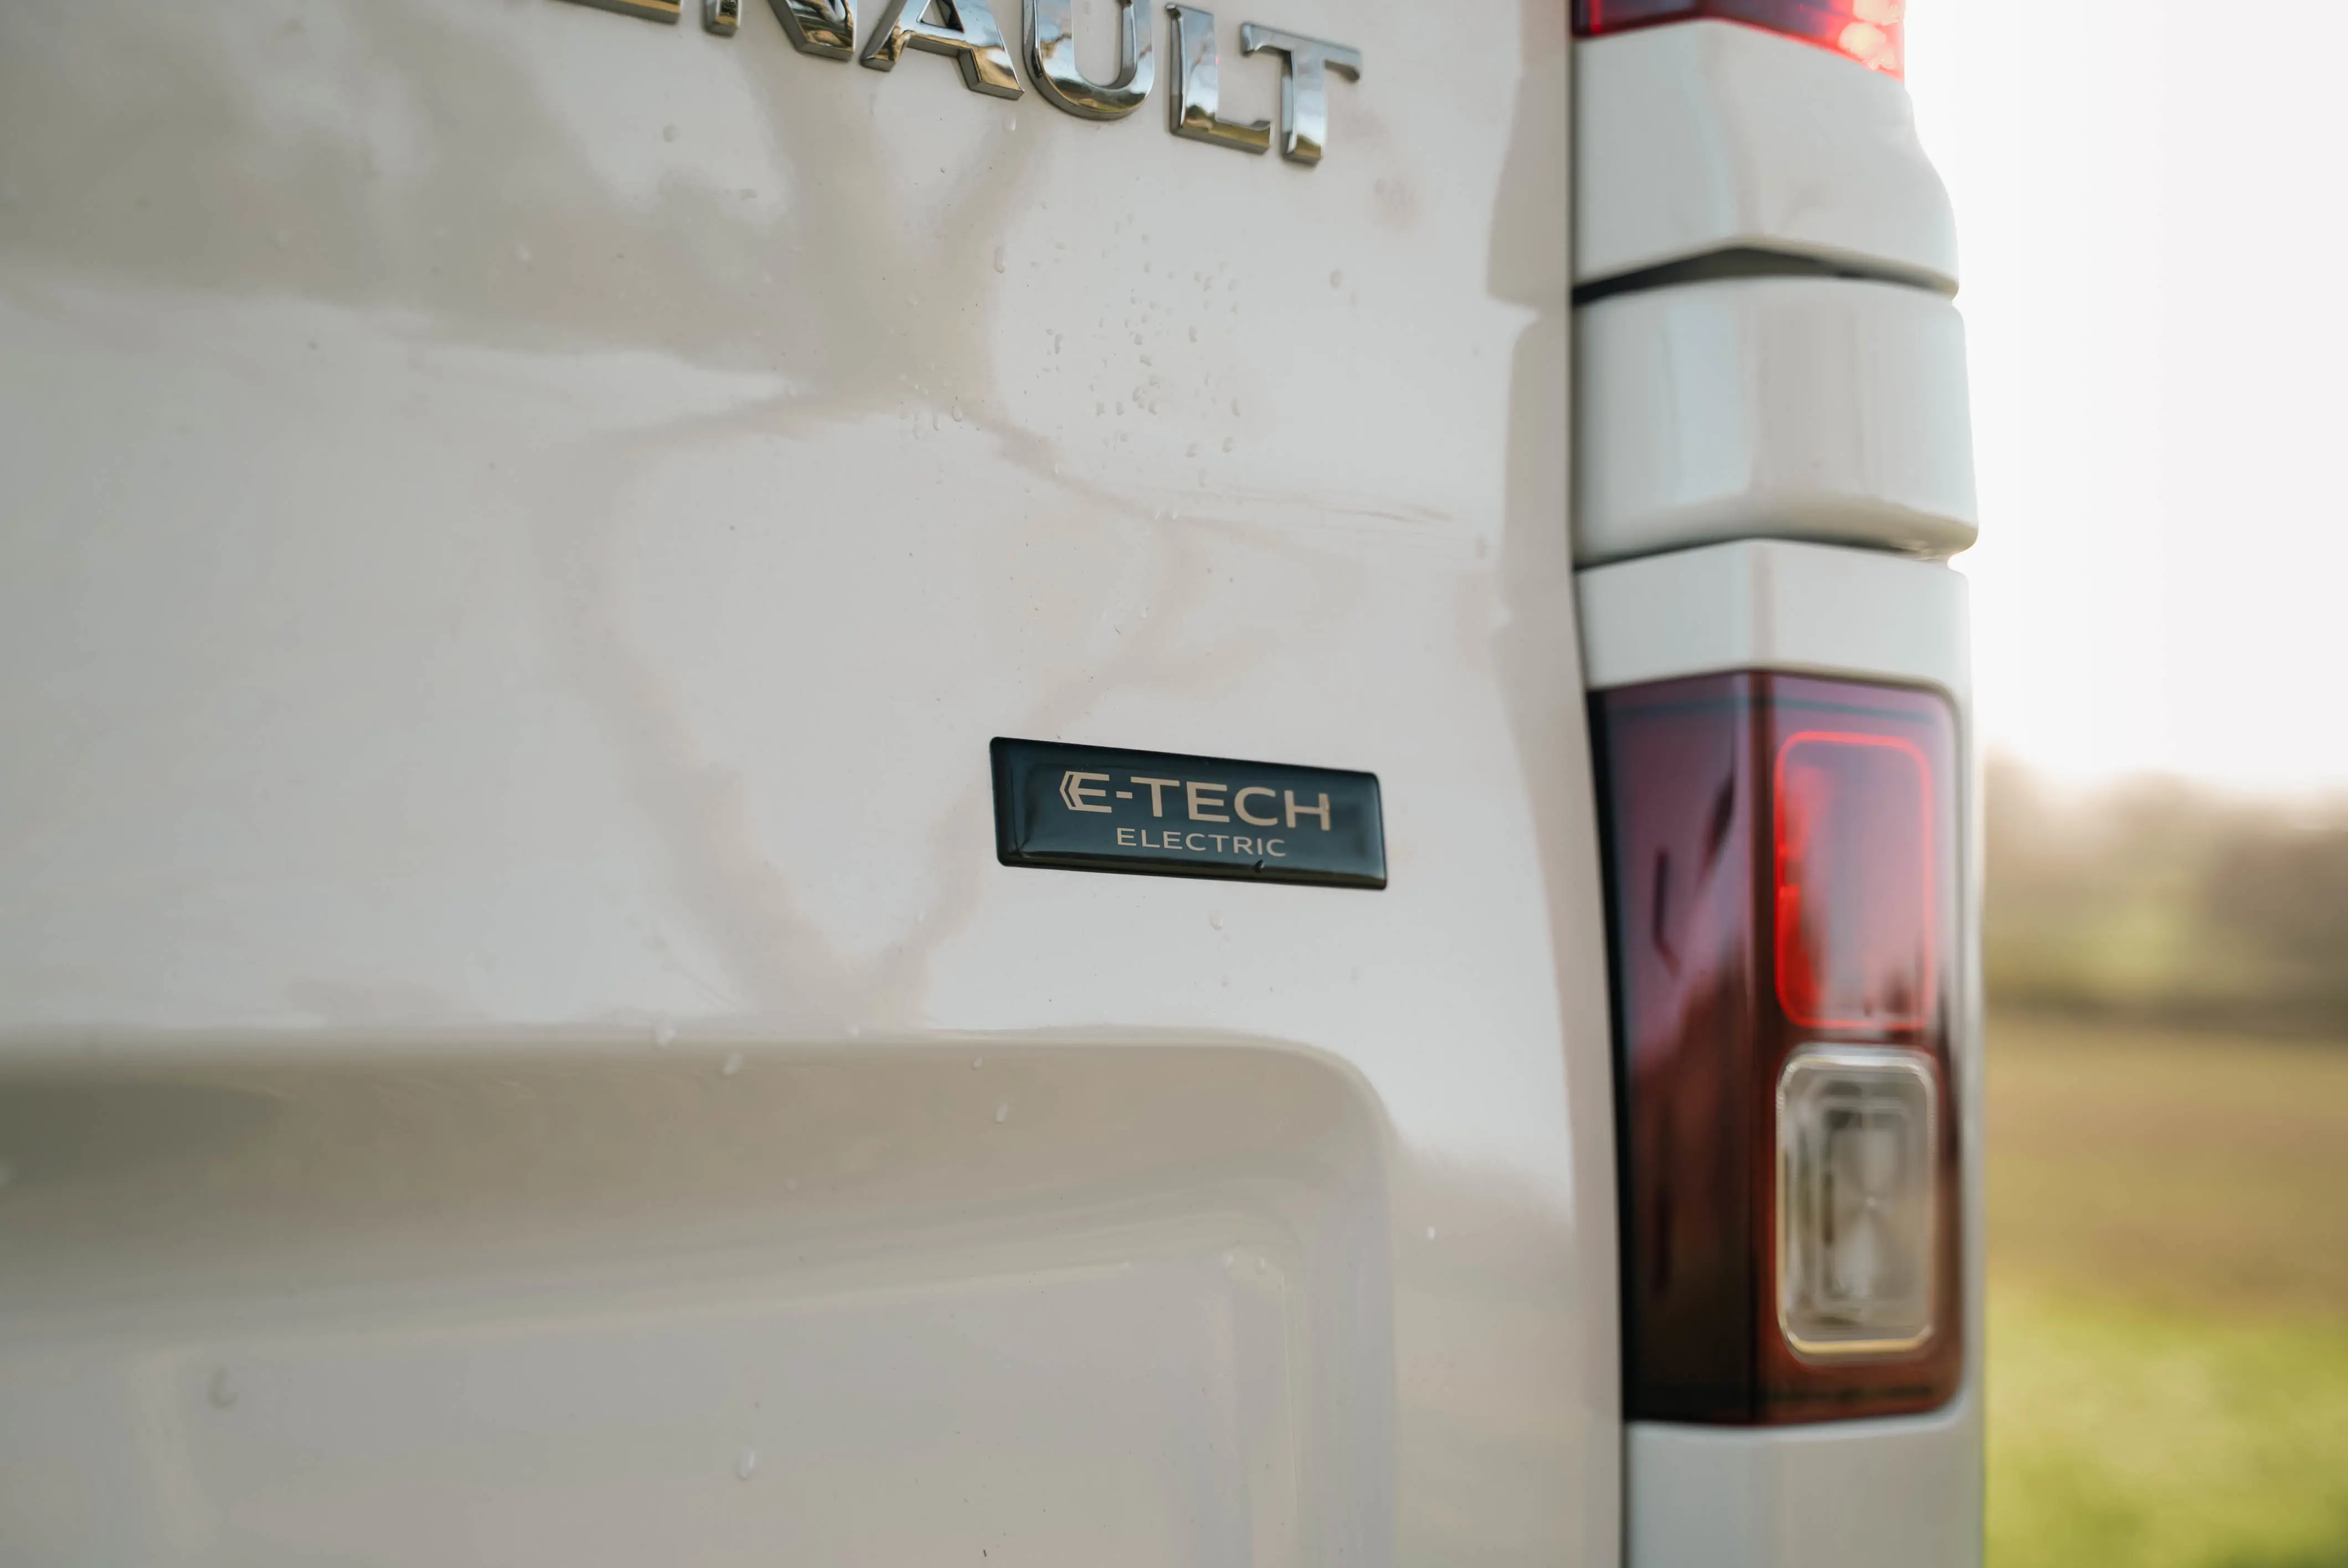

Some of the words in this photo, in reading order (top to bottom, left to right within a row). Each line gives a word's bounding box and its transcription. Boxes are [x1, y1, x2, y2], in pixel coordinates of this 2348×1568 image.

[545, 0, 1361, 165] AULT
[1059, 770, 1331, 832] E-TECH
[1116, 827, 1287, 858] ELECTRIC
